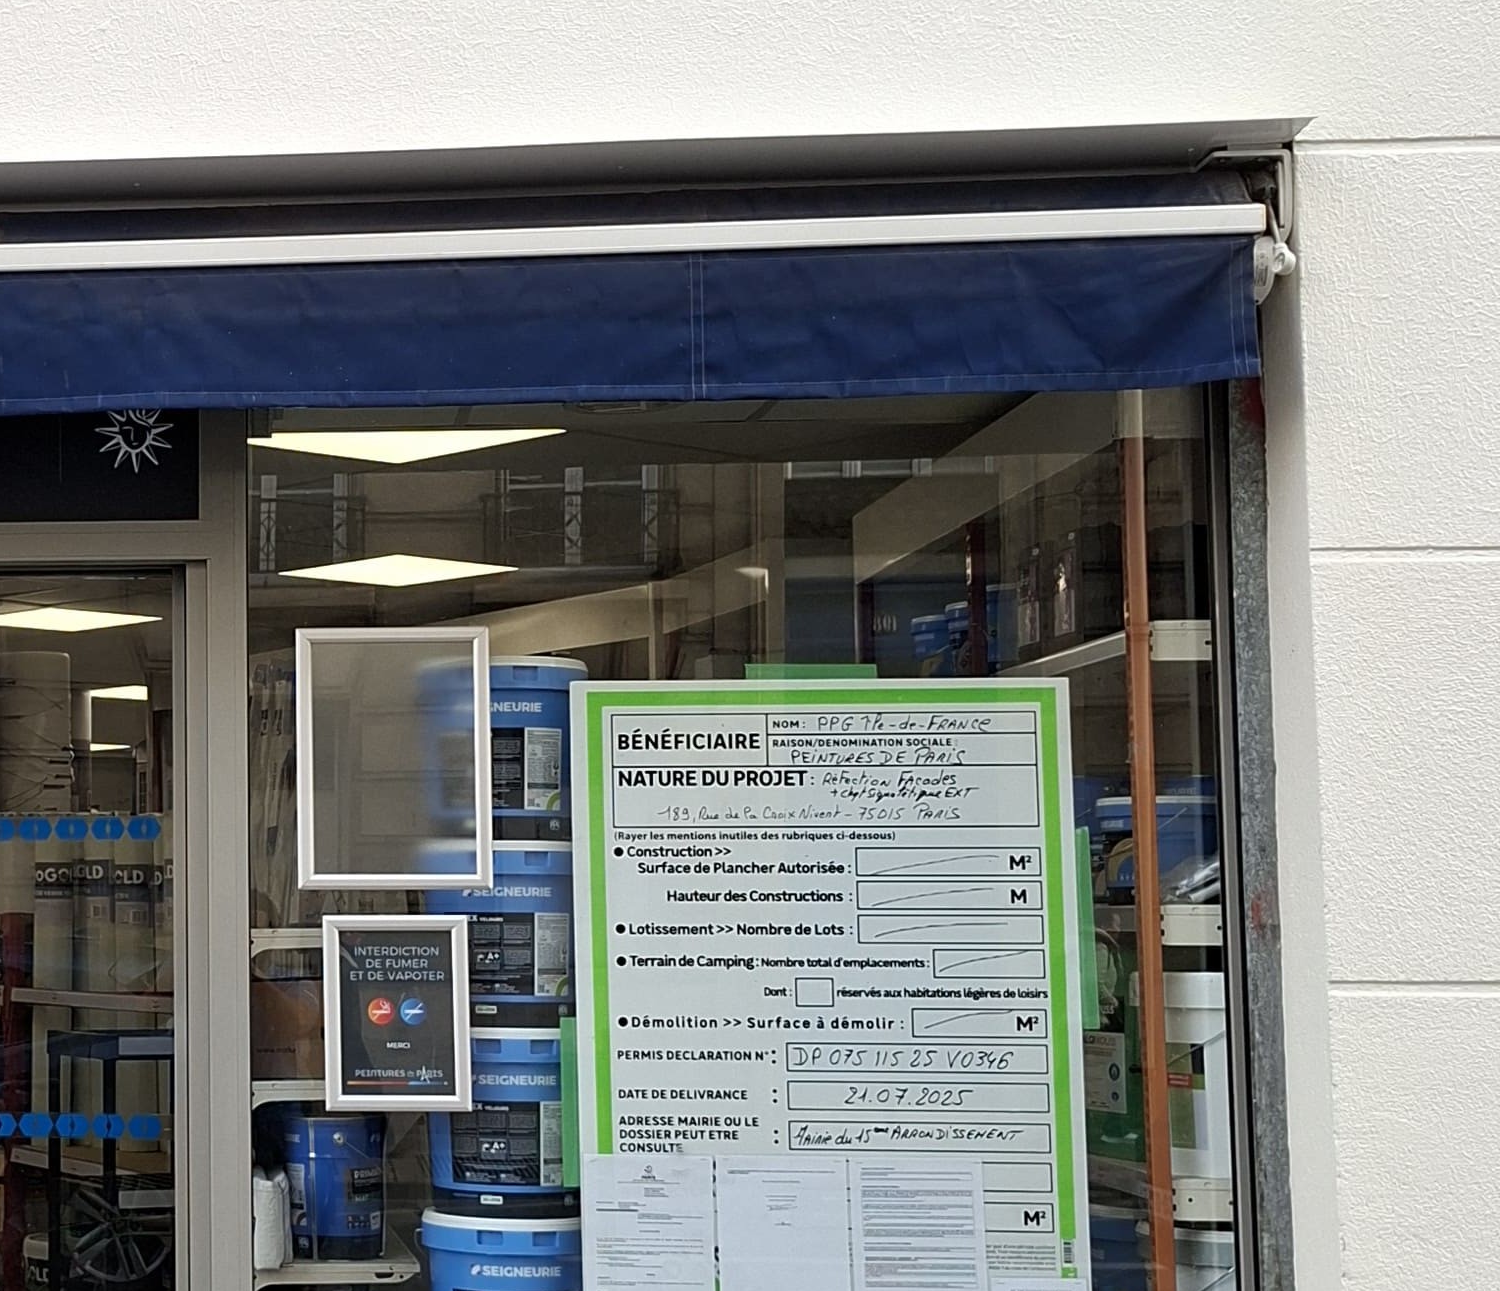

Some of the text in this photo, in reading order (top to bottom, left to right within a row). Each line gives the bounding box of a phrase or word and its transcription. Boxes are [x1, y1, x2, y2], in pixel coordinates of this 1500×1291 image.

[818, 716, 853, 732] PPG
[617, 728, 761, 749] BÉNÉFICIAIRE
[772, 739, 903, 747] RAISON/DENOMINATION
[880, 750, 907, 764] DE
[618, 770, 697, 787] NATURE
[702, 770, 729, 787] DU
[944, 787, 980, 799] EXT
[858, 806, 905, 821] 75015
[614, 831, 896, 842] (Rayer les mentions inutiles des rubriques ci-dessous)
[627, 846, 712, 858] Construction
[637, 862, 691, 874] Surface
[694, 862, 711, 874] de
[713, 862, 775, 874] Plancher
[667, 889, 1027, 904] Hauteur des Constructions M
[628, 924, 845, 936] Lotissement Nombre de Lots
[354, 946, 439, 957] INTERDICTION
[366, 959, 428, 969] DE FUMER
[629, 955, 676, 967] Terrain
[678, 955, 695, 967] de
[761, 957, 805, 968] Nombre
[806, 957, 833, 968] total
[350, 971, 445, 982] ET DE VAPOTER
[764, 987, 1048, 1000] Dont réservés aux habitations légères de loisirs
[631, 1015, 718, 1028] Démolition
[747, 1017, 811, 1029] Surface
[816, 1016, 825, 1029] à
[831, 1016, 895, 1029] démolir
[386, 1042, 411, 1050] MERCI
[617, 1050, 663, 1060] PERMIS
[666, 1050, 752, 1061] DECLARATION
[792, 1047, 822, 1066] DP
[829, 1048, 868, 1066] 075
[875, 1050, 905, 1067] 115
[909, 1049, 938, 1068] 25
[355, 1069, 406, 1079] PEINTURES
[478, 1075, 557, 1086] SEIGNEURIE
[618, 1087, 975, 1106] DATE DE DELIVRANCE 21.07.2025
[619, 1116, 759, 1127] ADRESSE MAIRIE OU LE
[619, 1129, 739, 1140] DOSSIER PEUT ETRE
[835, 1133, 852, 1146] du
[482, 1266, 562, 1277] SEIGNEURIE
